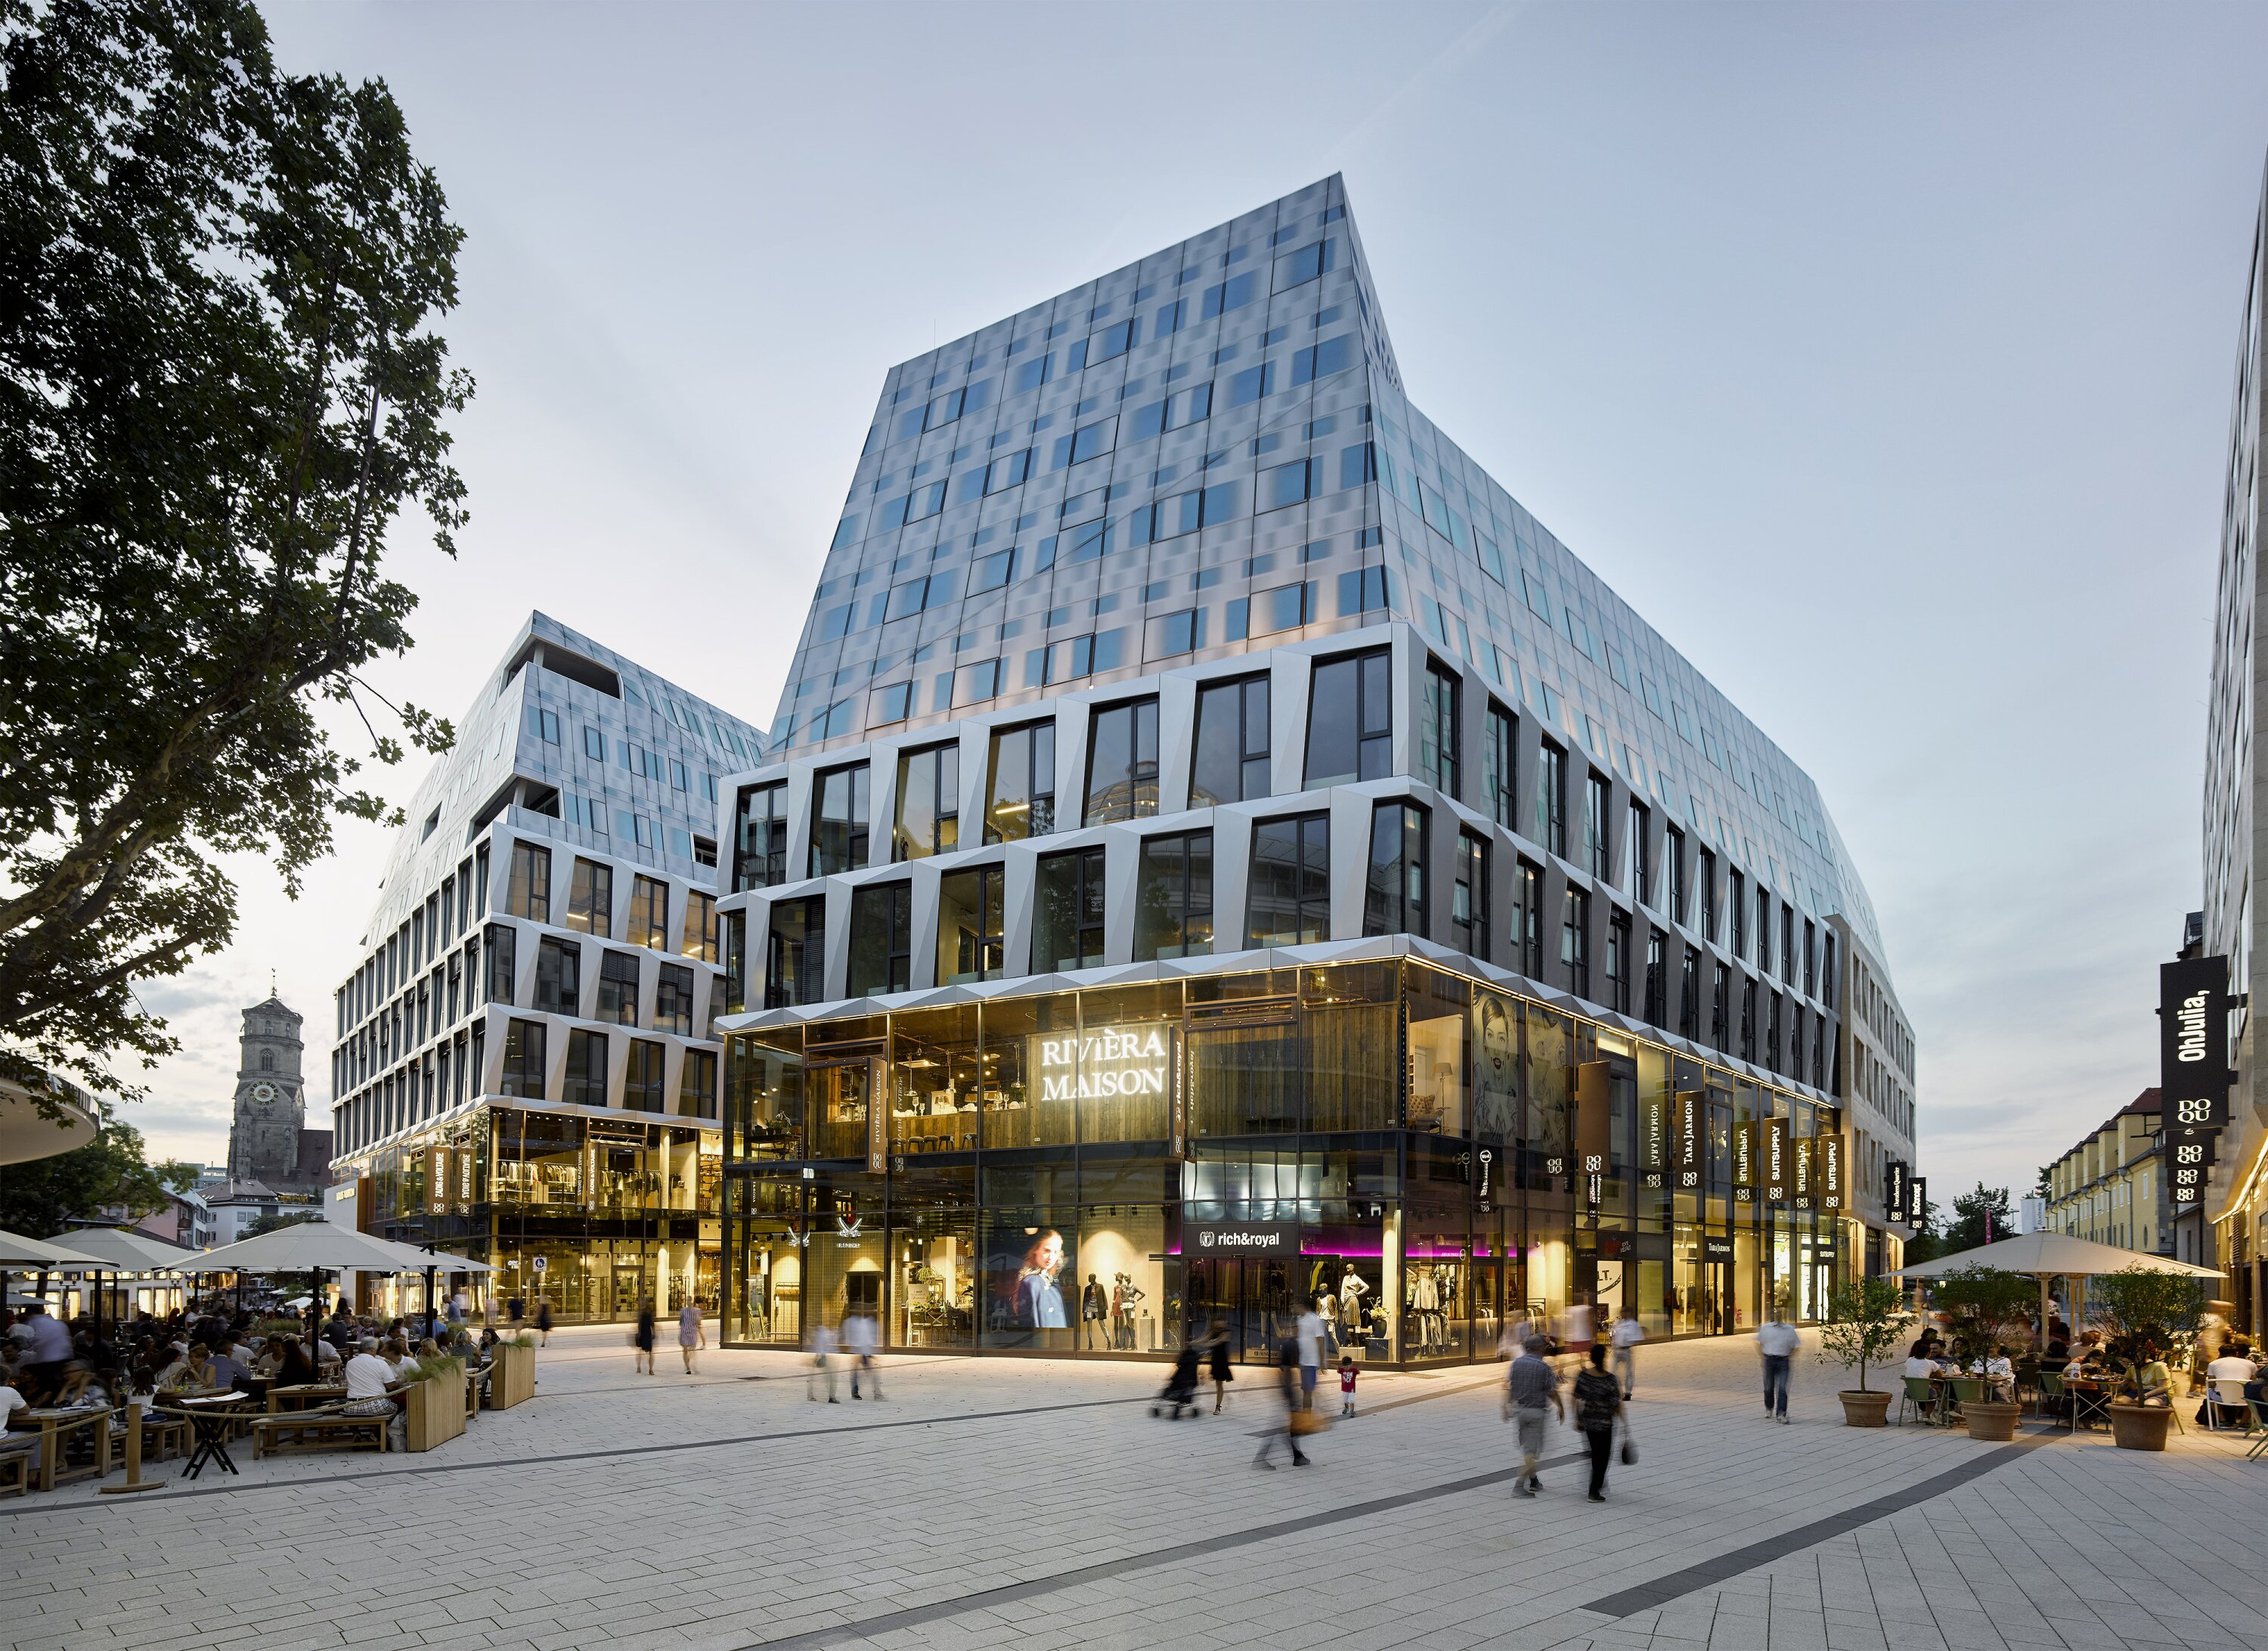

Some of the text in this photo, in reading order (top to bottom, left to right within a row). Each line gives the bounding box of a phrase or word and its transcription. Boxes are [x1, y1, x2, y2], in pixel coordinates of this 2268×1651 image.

[2177, 990, 2210, 1061] OhJulia,
[1041, 1028, 1166, 1066] RIVIÈRA
[1041, 1067, 1166, 1101] MAISON
[2178, 1098, 2211, 1111] DO
[2177, 1110, 2211, 1123] QU
[1684, 1101, 1694, 1164] TARA JARMON
[1771, 1126, 1780, 1180] SUITSUPPLY
[2177, 1145, 2202, 1154] DO
[873, 1153, 882, 1161] DO
[1586, 1155, 1601, 1164] DO
[2177, 1153, 2202, 1163] QU
[872, 1160, 882, 1169] QU
[1586, 1163, 1601, 1172] QU
[1828, 1141, 1836, 1191] SUITSUPPLY
[1682, 1178, 1697, 1186] QU
[2177, 1176, 2198, 1185] QU
[1218, 1232, 1279, 1248] rich&royal
